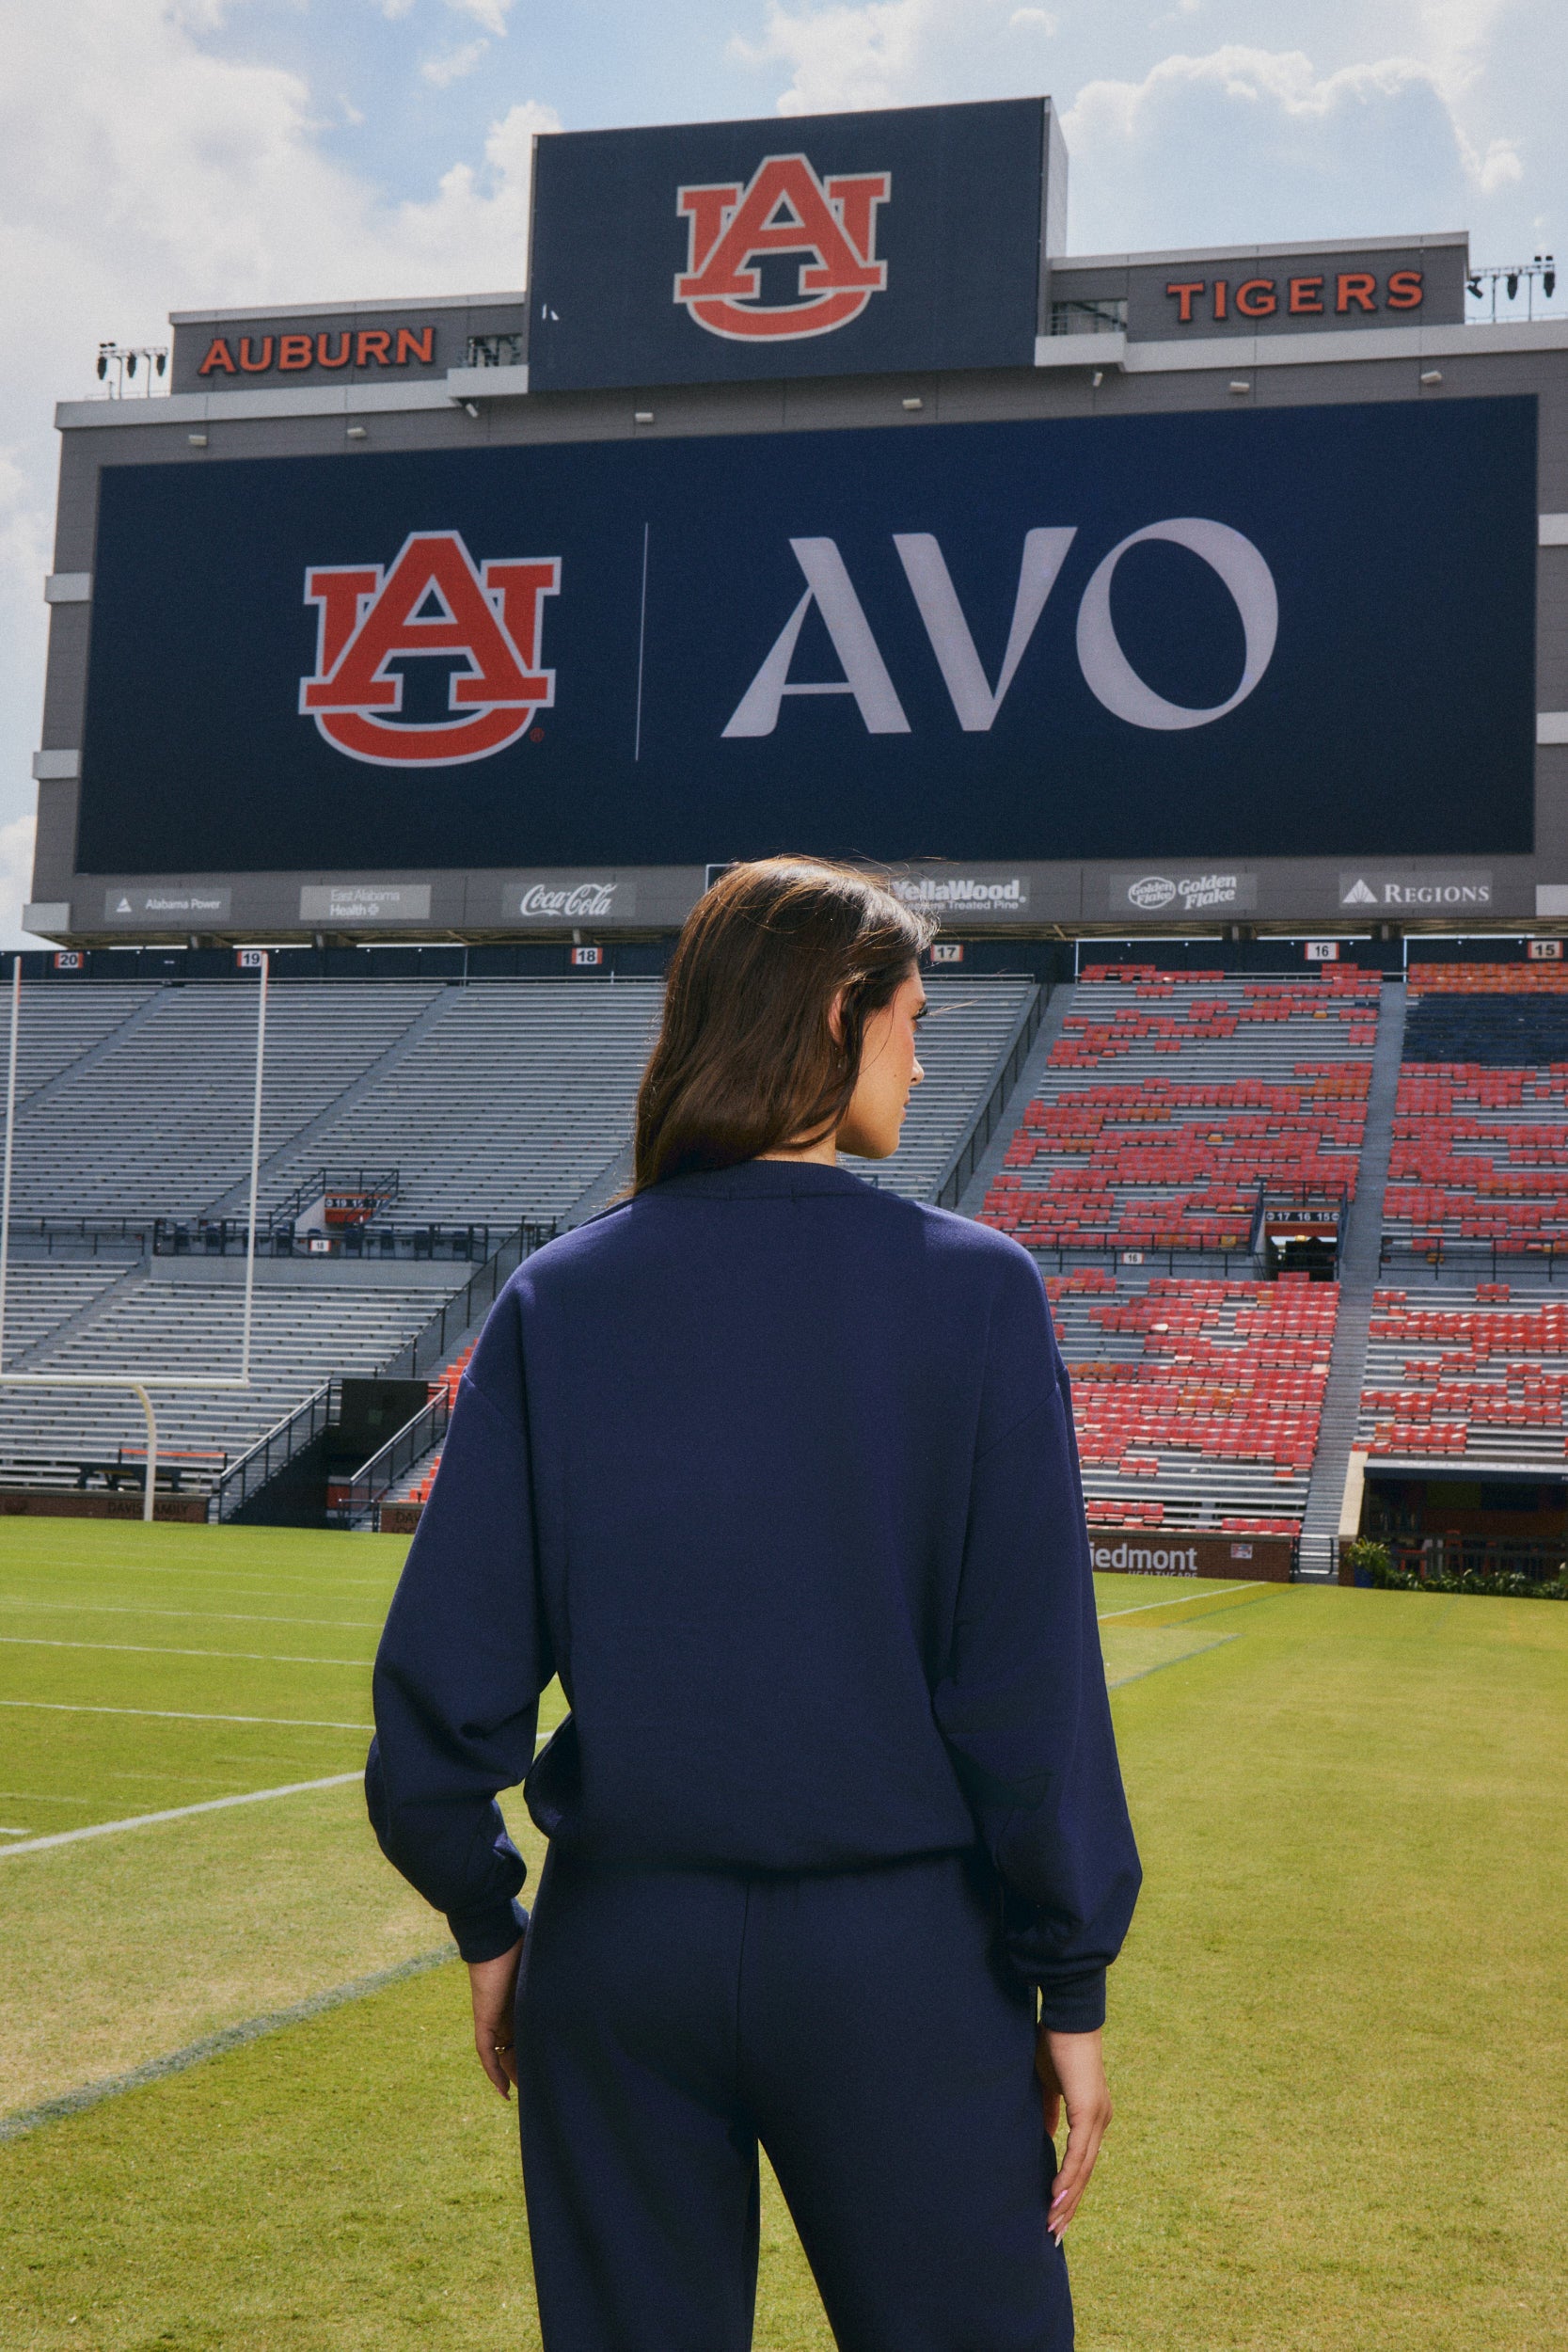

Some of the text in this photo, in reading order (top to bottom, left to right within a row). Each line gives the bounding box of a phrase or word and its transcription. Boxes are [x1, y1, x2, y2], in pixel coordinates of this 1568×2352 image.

[1166, 270, 1424, 322] TIGERS
[198, 327, 435, 374] AUBURN
[720, 516, 1279, 738] AVO
[1132, 882, 1173, 896] Golden
[1178, 875, 1237, 895] Golden
[331, 889, 400, 901] East Alabama
[520, 883, 617, 915] Coca-Cola
[1136, 891, 1173, 904] Flake
[1185, 888, 1235, 910] Flake
[1385, 883, 1490, 903] REGIONS
[146, 898, 221, 910] Alabama Power
[330, 903, 367, 915] Health
[949, 900, 990, 910] Treated
[994, 899, 1019, 910] Pine
[578, 950, 596, 962] 18
[938, 946, 957, 958] 17
[1315, 945, 1329, 957] 16
[1534, 944, 1556, 956] 15
[60, 954, 78, 965] 20
[243, 952, 261, 965] 19
[1277, 1212, 1330, 1221] 17 16 15
[1090, 1541, 1197, 1571] iedmont
